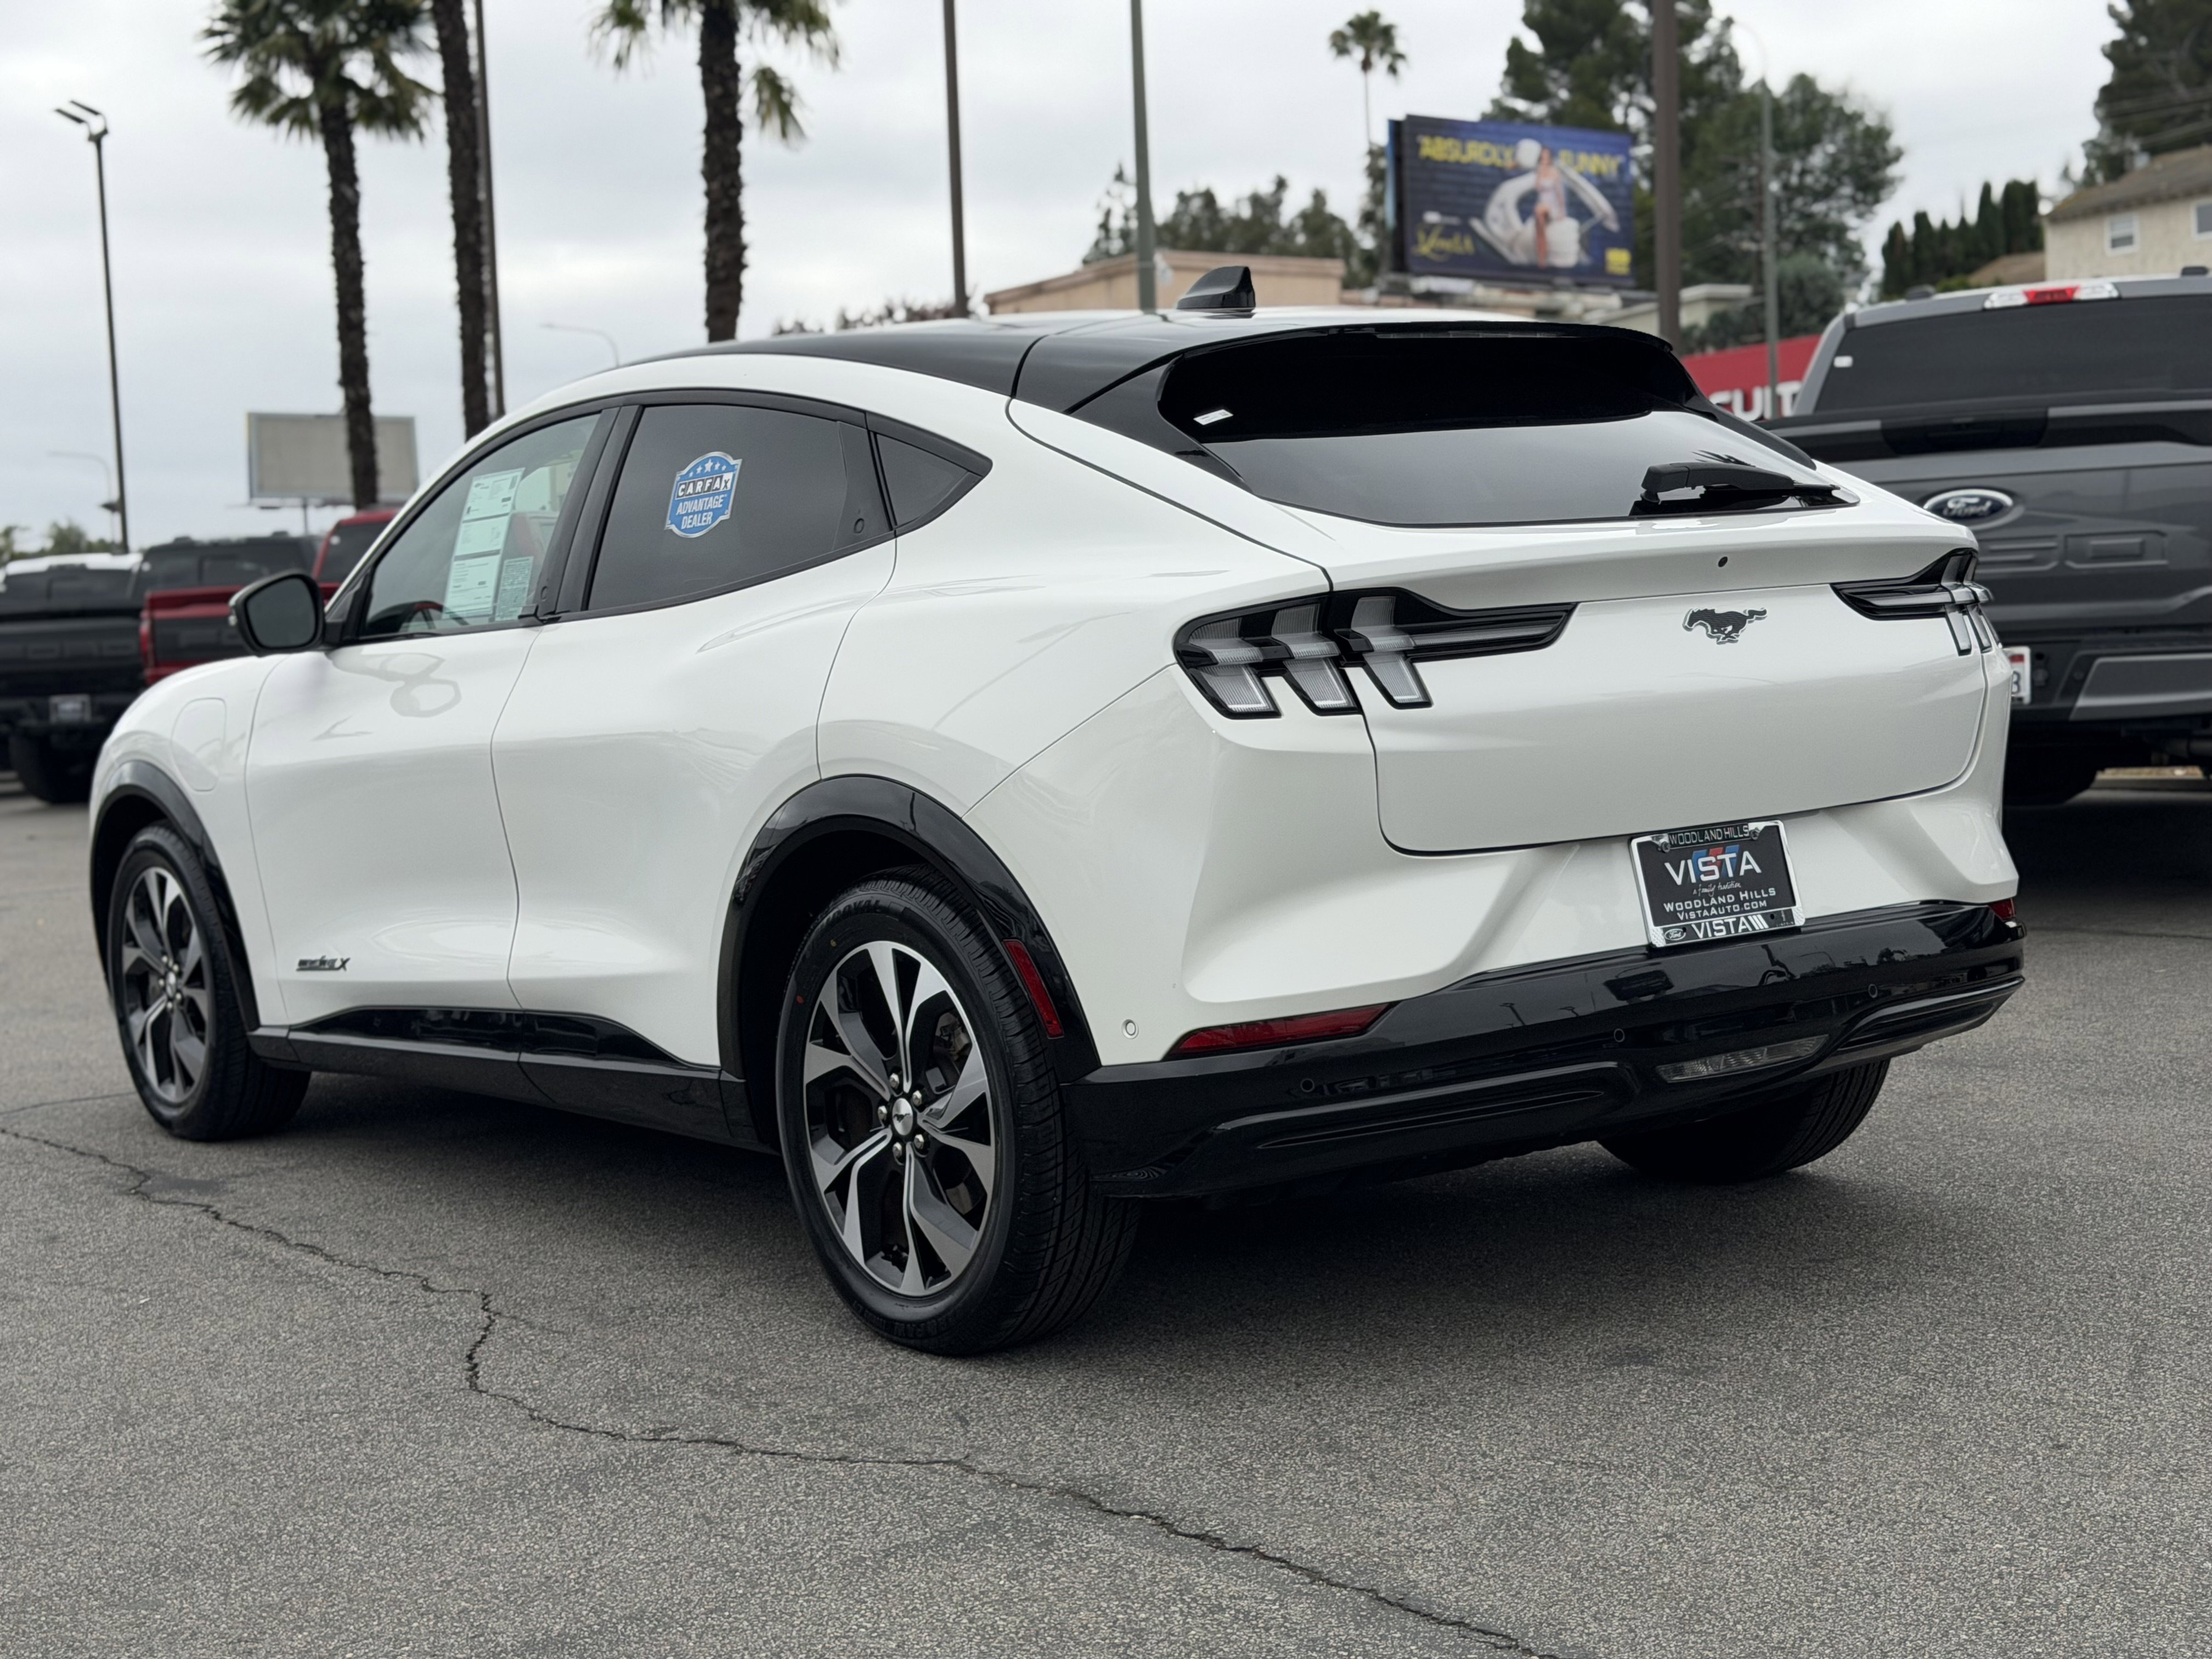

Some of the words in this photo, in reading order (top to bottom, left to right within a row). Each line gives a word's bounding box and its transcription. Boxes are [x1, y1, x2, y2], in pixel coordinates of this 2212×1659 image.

[678, 477, 730, 496] CARFAX
[676, 496, 724, 516] ADVANTAGE
[1943, 496, 1992, 517] Ford
[681, 511, 713, 529] DEALER
[1669, 828, 1723, 845] WOODLAND
[1724, 825, 1750, 838] HILLS
[1664, 851, 1762, 885] VISTA
[1698, 883, 1716, 897] family
[1691, 916, 1752, 939] VISTA
